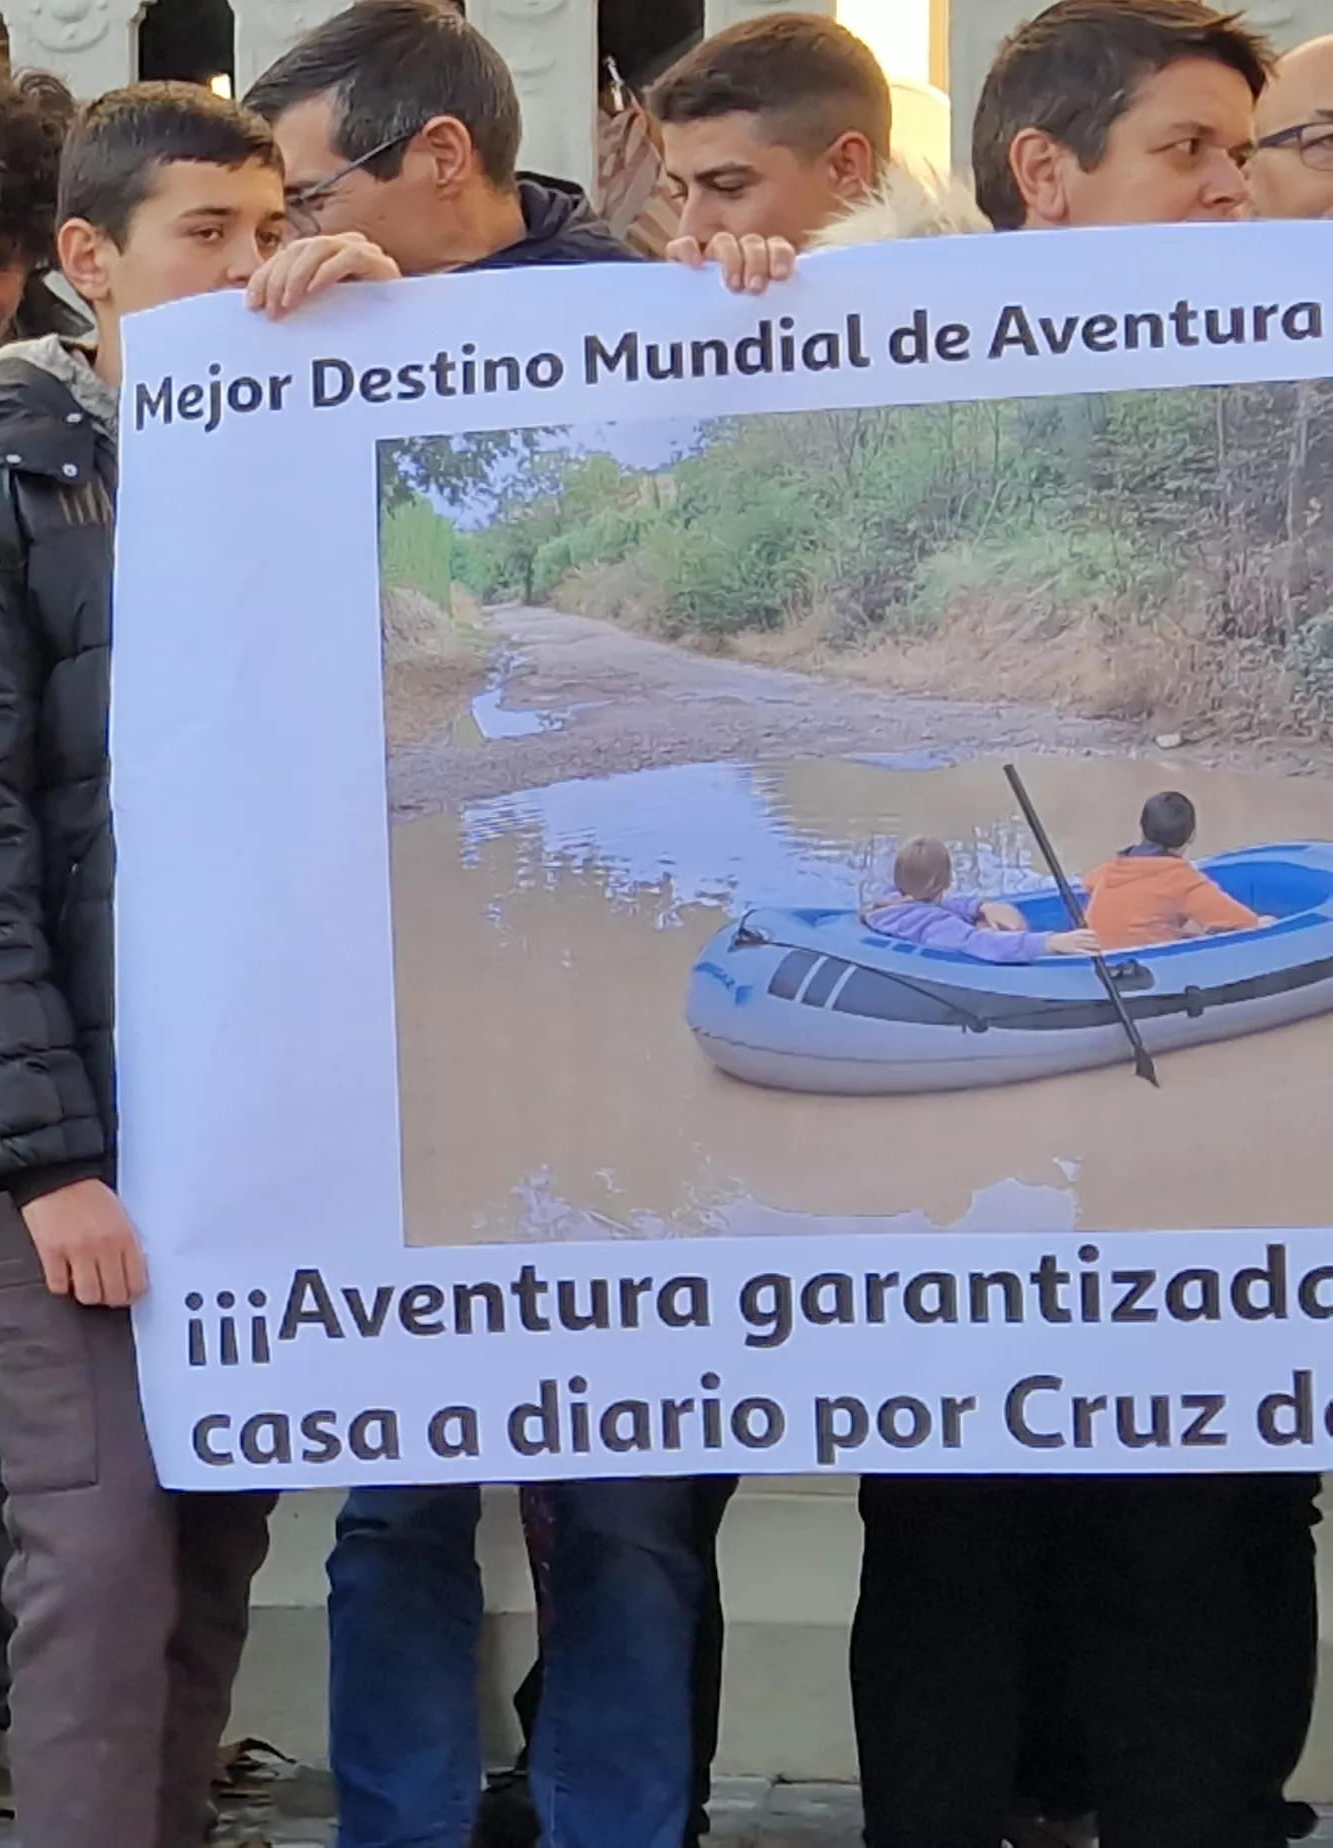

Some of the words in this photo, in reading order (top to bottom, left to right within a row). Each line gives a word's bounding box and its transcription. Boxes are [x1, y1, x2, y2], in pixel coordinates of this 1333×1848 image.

[134, 362, 293, 434] Mejor
[310, 342, 565, 409] Destino
[583, 313, 871, 386] Mundial
[887, 308, 971, 366] de
[986, 299, 1323, 360] Aventura
[191, 1407, 401, 1466] casa
[426, 1404, 481, 1458] a
[506, 1371, 786, 1458] diario
[814, 1395, 977, 1466] por
[1003, 1373, 1229, 1449] Cruz
[1255, 1368, 1333, 1446] d
